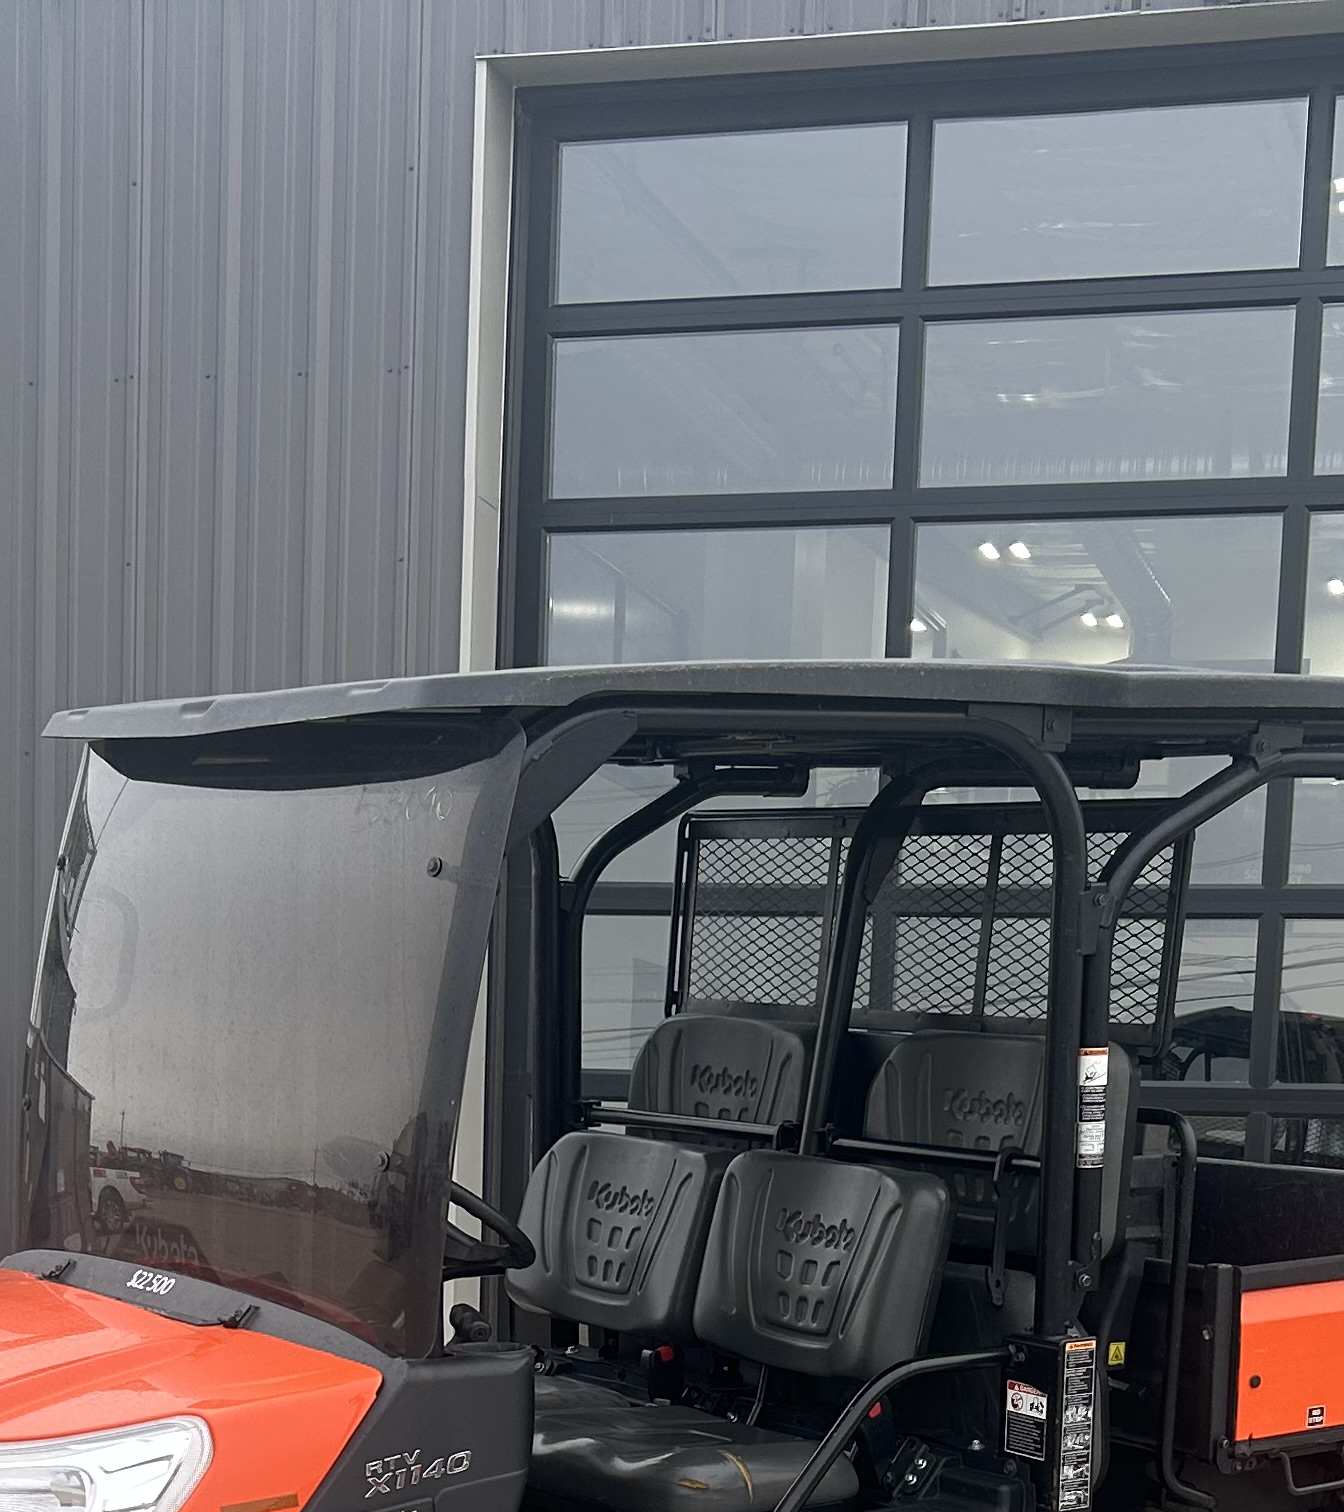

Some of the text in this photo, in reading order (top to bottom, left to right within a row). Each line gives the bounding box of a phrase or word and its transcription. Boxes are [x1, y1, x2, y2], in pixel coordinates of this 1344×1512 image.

[690, 1063, 758, 1098] Kubota
[943, 1087, 1025, 1127] Kubota
[587, 1180, 655, 1218] Kubota
[775, 1207, 856, 1251] Kubota
[364, 1450, 472, 1499] X1140
[365, 1449, 421, 1477] RTV
